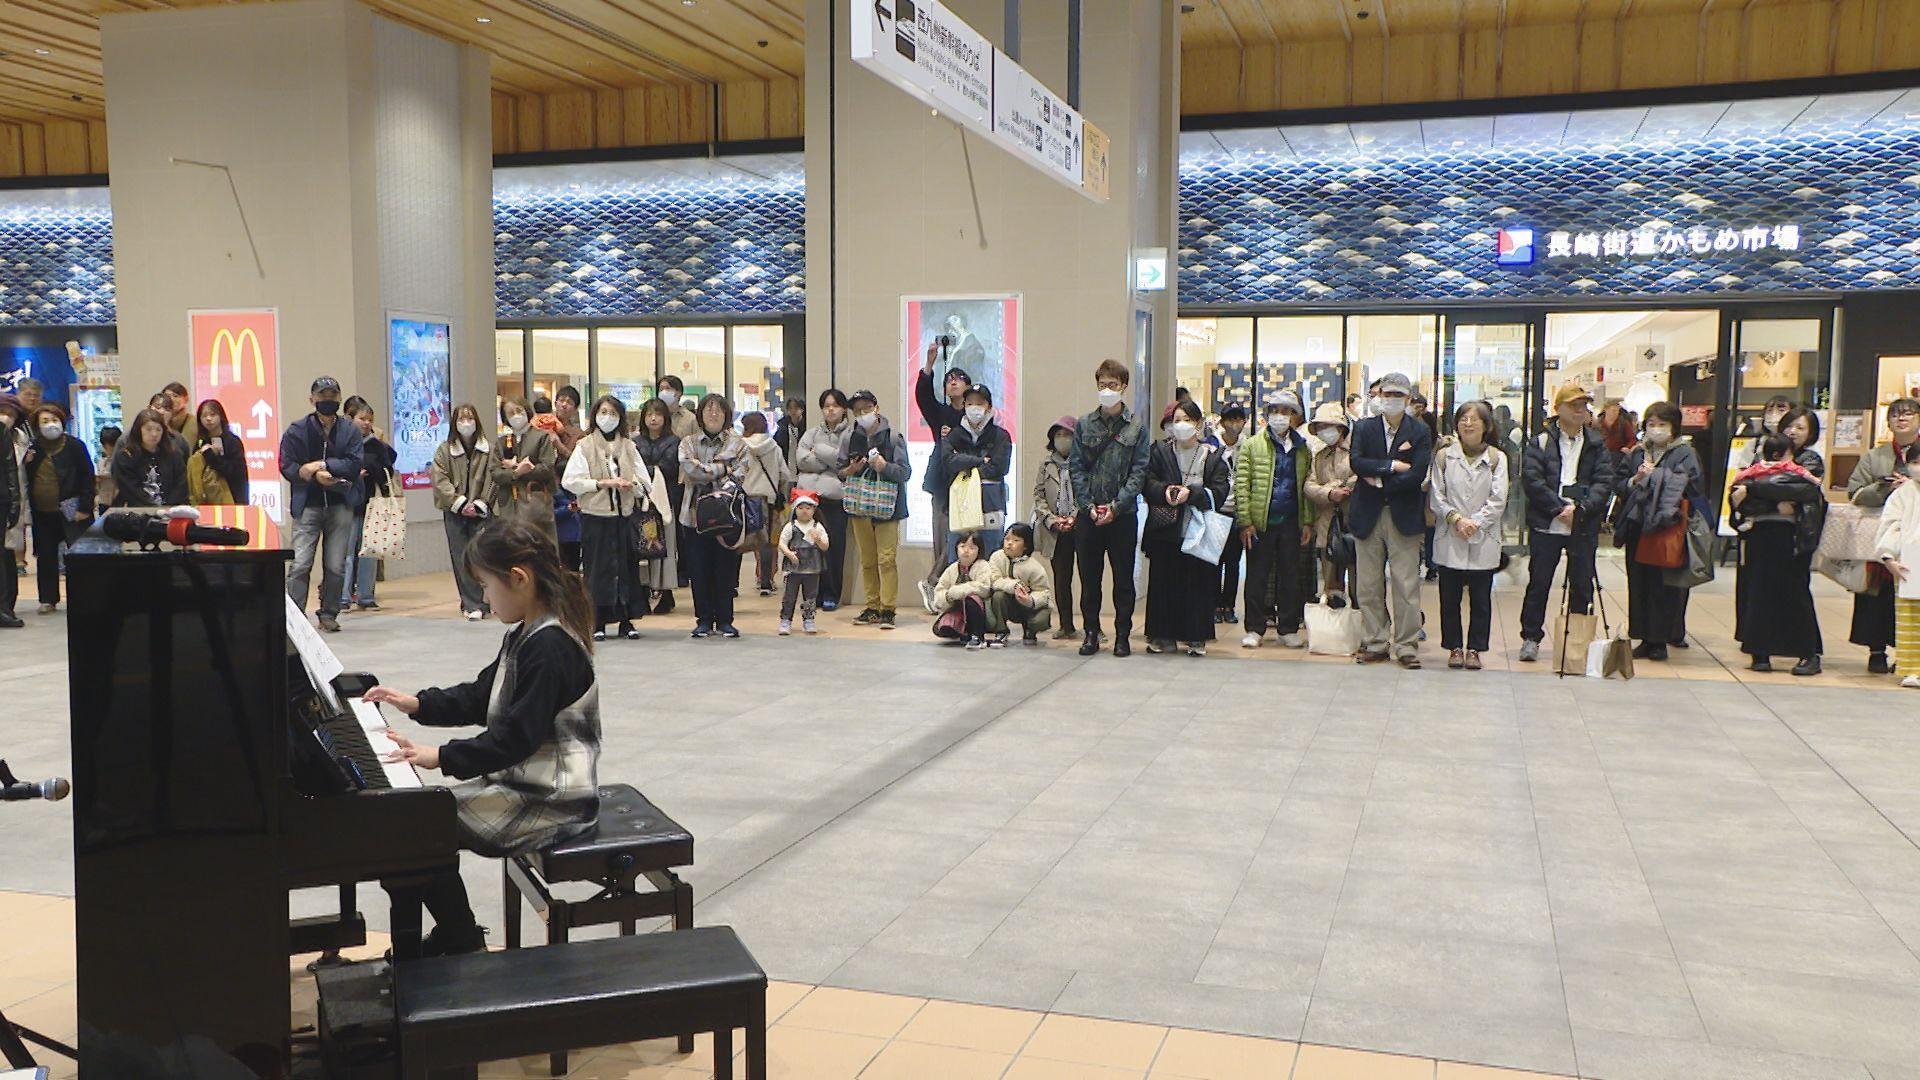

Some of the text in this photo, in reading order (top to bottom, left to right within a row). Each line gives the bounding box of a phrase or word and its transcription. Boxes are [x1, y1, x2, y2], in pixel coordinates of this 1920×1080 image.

[1547, 225, 1801, 258] 長崎街道かもめ市場
